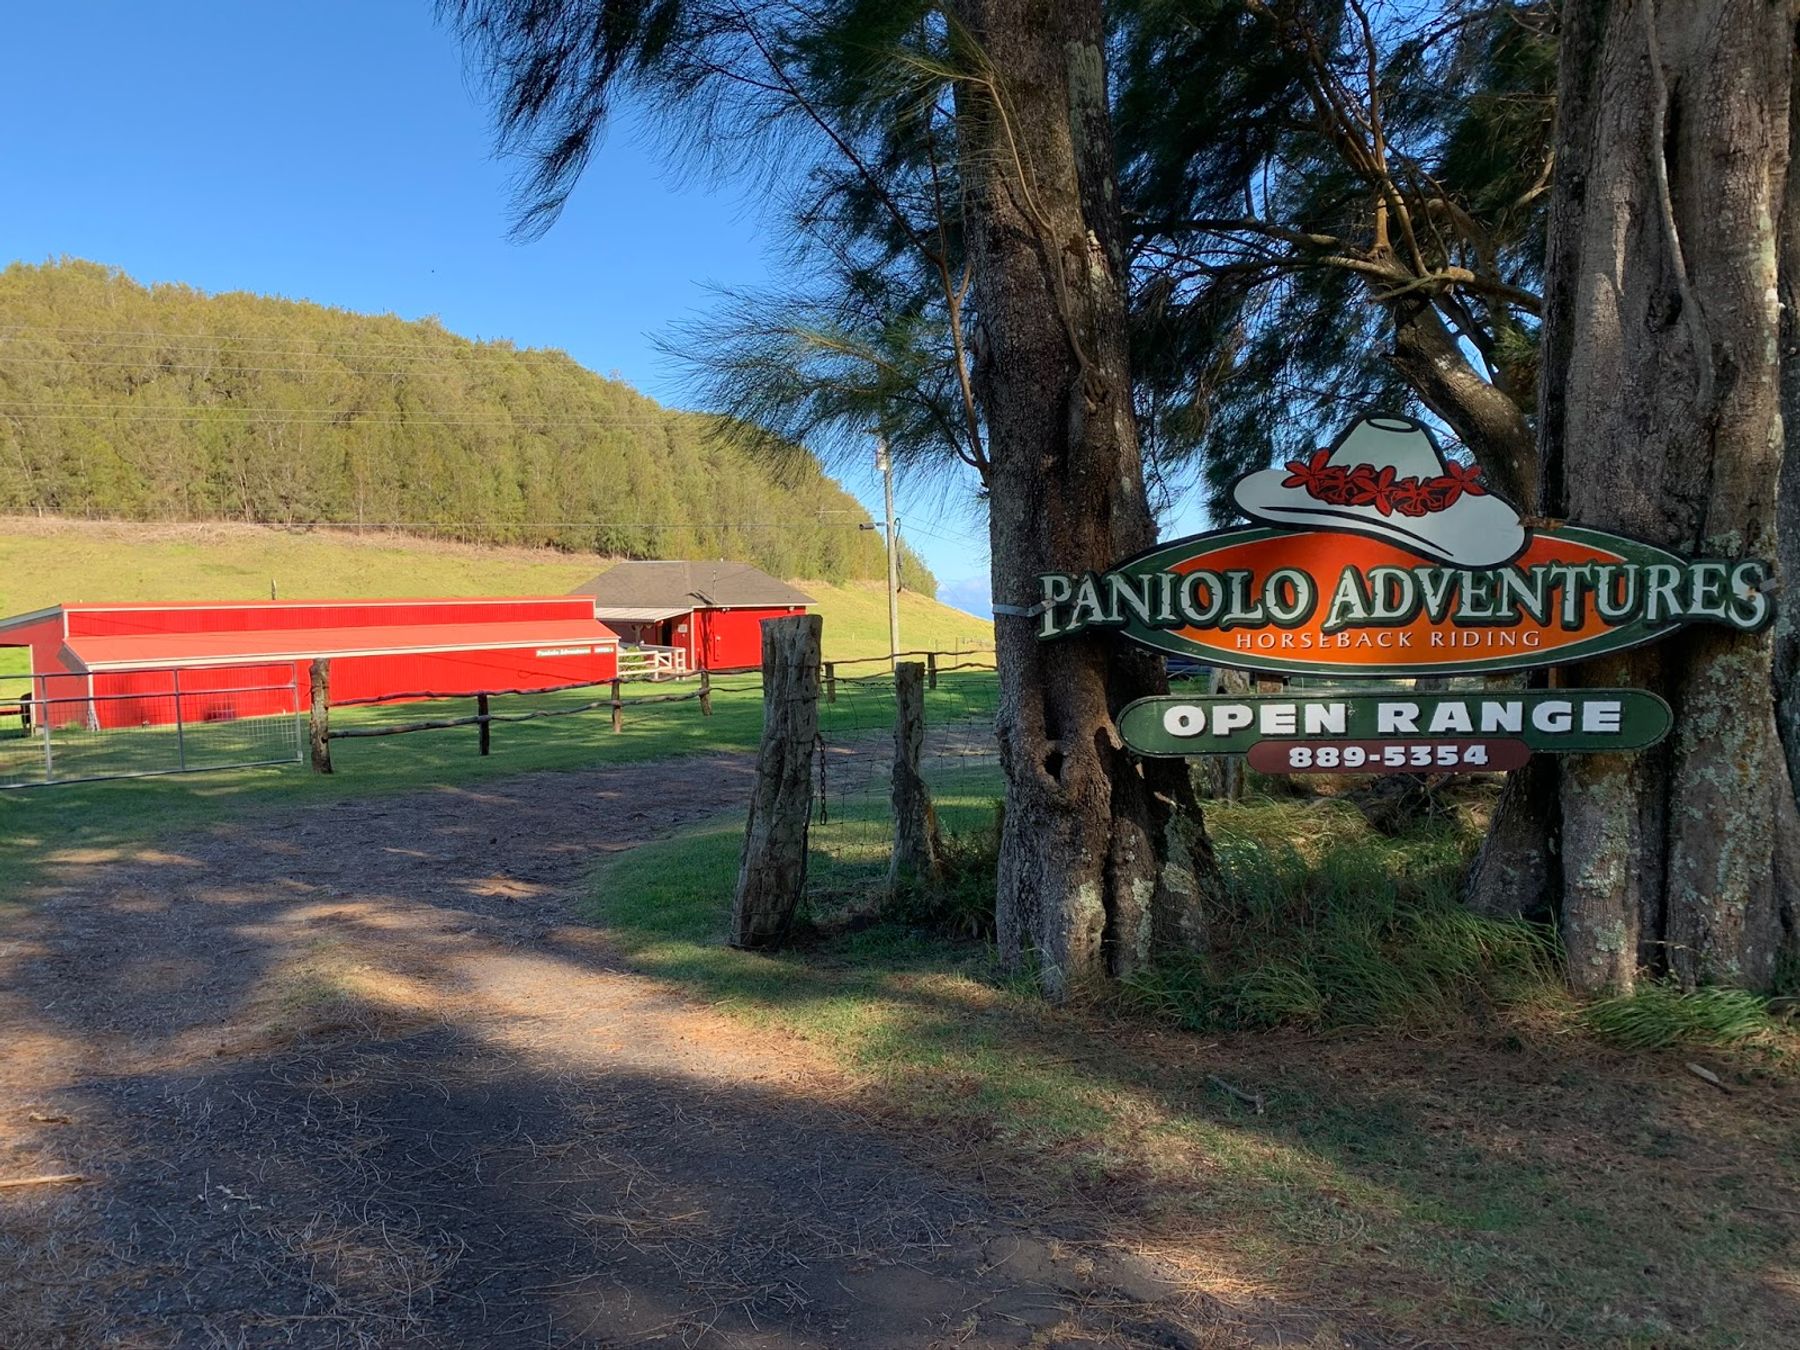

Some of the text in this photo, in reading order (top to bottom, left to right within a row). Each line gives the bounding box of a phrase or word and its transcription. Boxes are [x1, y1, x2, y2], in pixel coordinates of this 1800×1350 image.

[1039, 562, 1768, 637] PANIOLO ADVENTURES
[1236, 630, 1539, 649] HORSEBACK RIDING
[1163, 701, 1621, 736] OPEN RANGE
[1289, 745, 1488, 768] 889-5354
